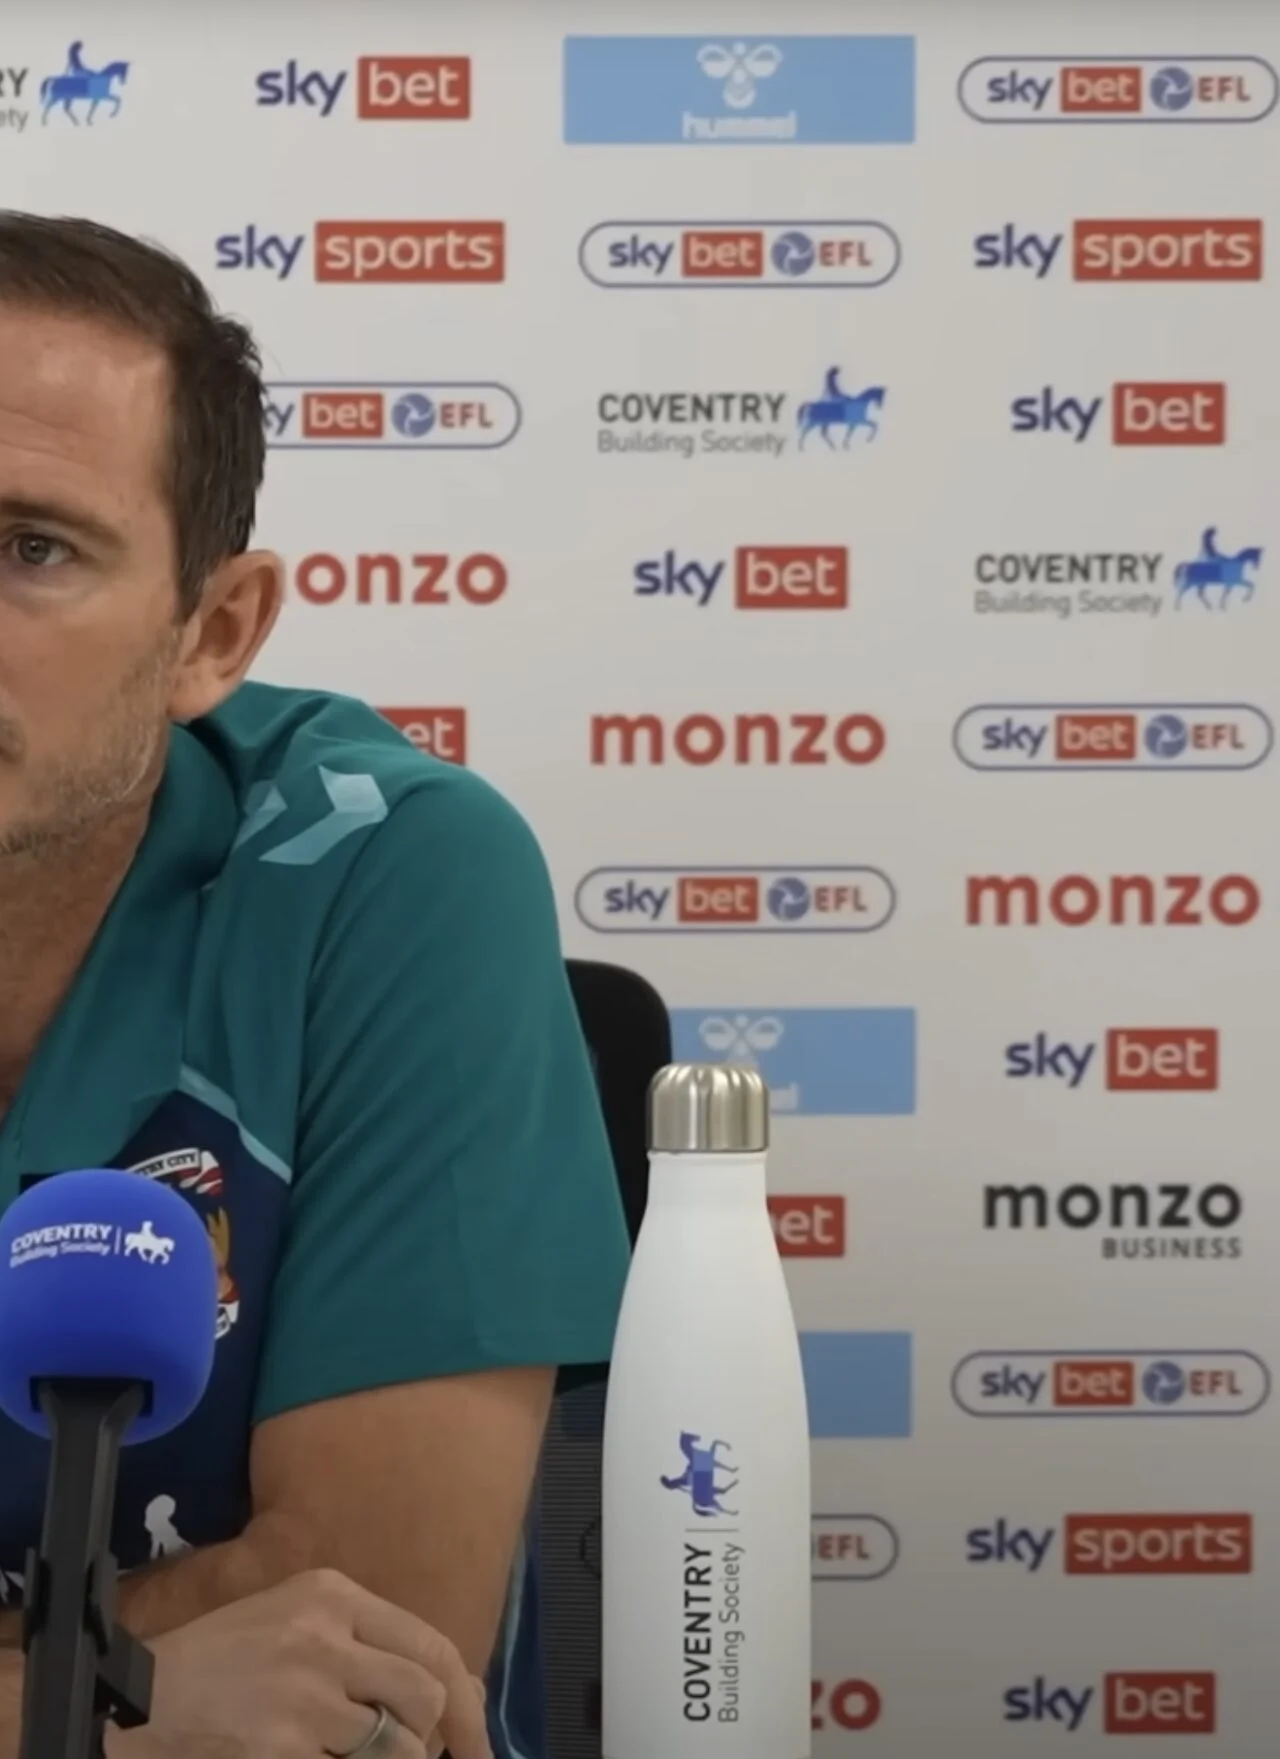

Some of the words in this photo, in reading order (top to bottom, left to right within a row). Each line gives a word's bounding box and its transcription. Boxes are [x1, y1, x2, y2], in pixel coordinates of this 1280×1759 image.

[256, 60, 346, 117] sky
[370, 63, 458, 105] bet
[987, 70, 1053, 110] sky
[1068, 71, 1132, 102] bet
[1197, 76, 1250, 102] EFL
[216, 225, 304, 279] sky
[325, 231, 494, 278] sports
[609, 235, 674, 275] sky
[690, 237, 754, 267] bet
[818, 241, 871, 267] EFL
[974, 223, 1062, 278] sky
[1082, 229, 1252, 275] sports
[310, 398, 374, 428] bet
[440, 403, 492, 428] EFL
[599, 393, 785, 423] COVENTRY
[1012, 386, 1102, 442] sky
[1124, 389, 1213, 431] bet
[597, 429, 695, 459] Building
[701, 429, 787, 458] Society
[283, 552, 508, 606] onzo
[634, 550, 724, 606] sky
[747, 552, 836, 595] bet
[976, 553, 1162, 583] COVENTRY
[974, 589, 1072, 620] Building
[1078, 590, 1162, 616] Society
[401, 716, 455, 758] et
[591, 714, 885, 765] monzo
[983, 718, 1047, 757] sky
[1063, 720, 1126, 750] bet
[1193, 725, 1244, 750] EFL
[605, 880, 670, 920] sky
[685, 882, 749, 912] bet
[814, 886, 867, 912] EFL
[967, 875, 1260, 926] monzo
[1006, 1033, 1095, 1088] sky
[1118, 1035, 1206, 1077] bet
[768, 1204, 835, 1246] et
[984, 1184, 1241, 1229] monzo
[10, 1223, 112, 1254] COVENTRY
[1102, 1237, 1241, 1259] BUSINESS
[981, 1365, 1046, 1404] sky
[1061, 1365, 1124, 1396] bet
[1190, 1372, 1242, 1398] EFL
[819, 1534, 870, 1560] EFL
[967, 1518, 1054, 1572] sky
[1074, 1524, 1242, 1569] sports
[718, 1543, 745, 1624] Society
[683, 1543, 712, 1722] COVENTRY
[718, 1631, 745, 1723] Building
[1004, 1677, 1093, 1731] sky
[1116, 1678, 1204, 1720] bet
